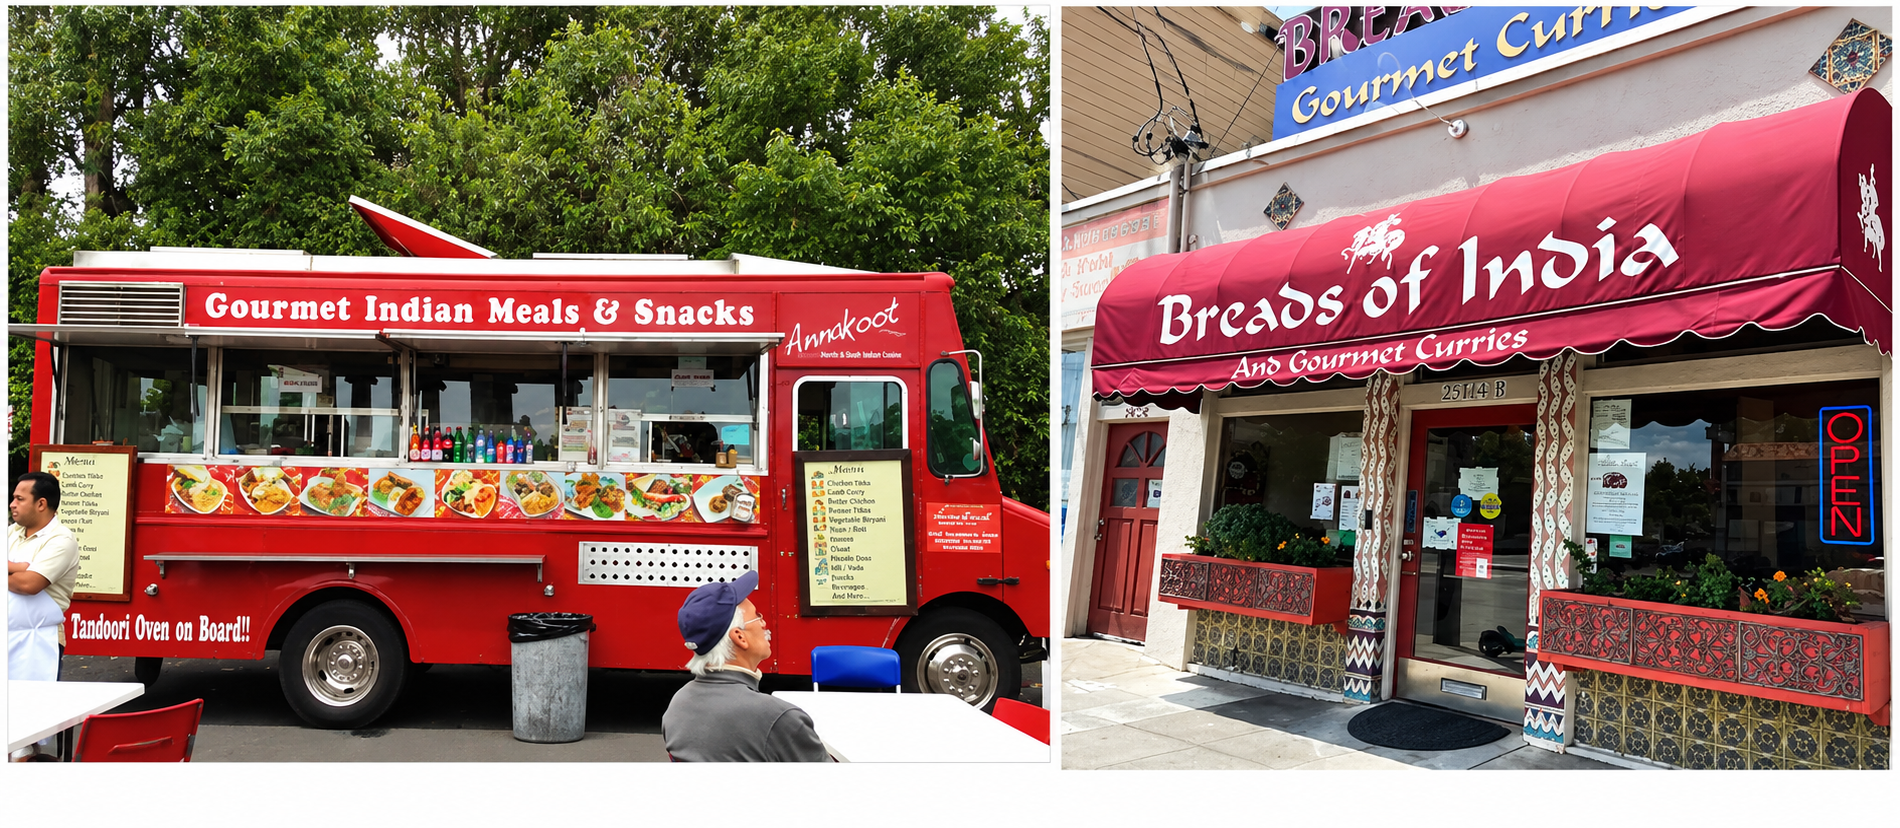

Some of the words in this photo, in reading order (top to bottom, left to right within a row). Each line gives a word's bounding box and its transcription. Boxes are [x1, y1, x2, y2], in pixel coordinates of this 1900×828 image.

[1291, 37, 1480, 124] Gourmet
[205, 292, 351, 320] Gourmet
[365, 295, 474, 323] Indian
[488, 297, 580, 325] Meals
[593, 298, 620, 326] &
[634, 298, 755, 326] Snacks
[1157, 283, 1345, 346] Breads
[1362, 245, 1440, 319] of
[1458, 217, 1680, 307] India
[785, 296, 900, 356] Annakoot
[1230, 354, 1282, 379] And
[1288, 342, 1406, 373] Gourmet
[1415, 327, 1529, 361] Curries
[1495, 380, 1505, 398] B
[1826, 412, 1864, 538] OPEN
[71, 613, 130, 640] Tandoori
[135, 614, 170, 641] Oven
[175, 620, 193, 641] on
[199, 615, 251, 642] Board!!
